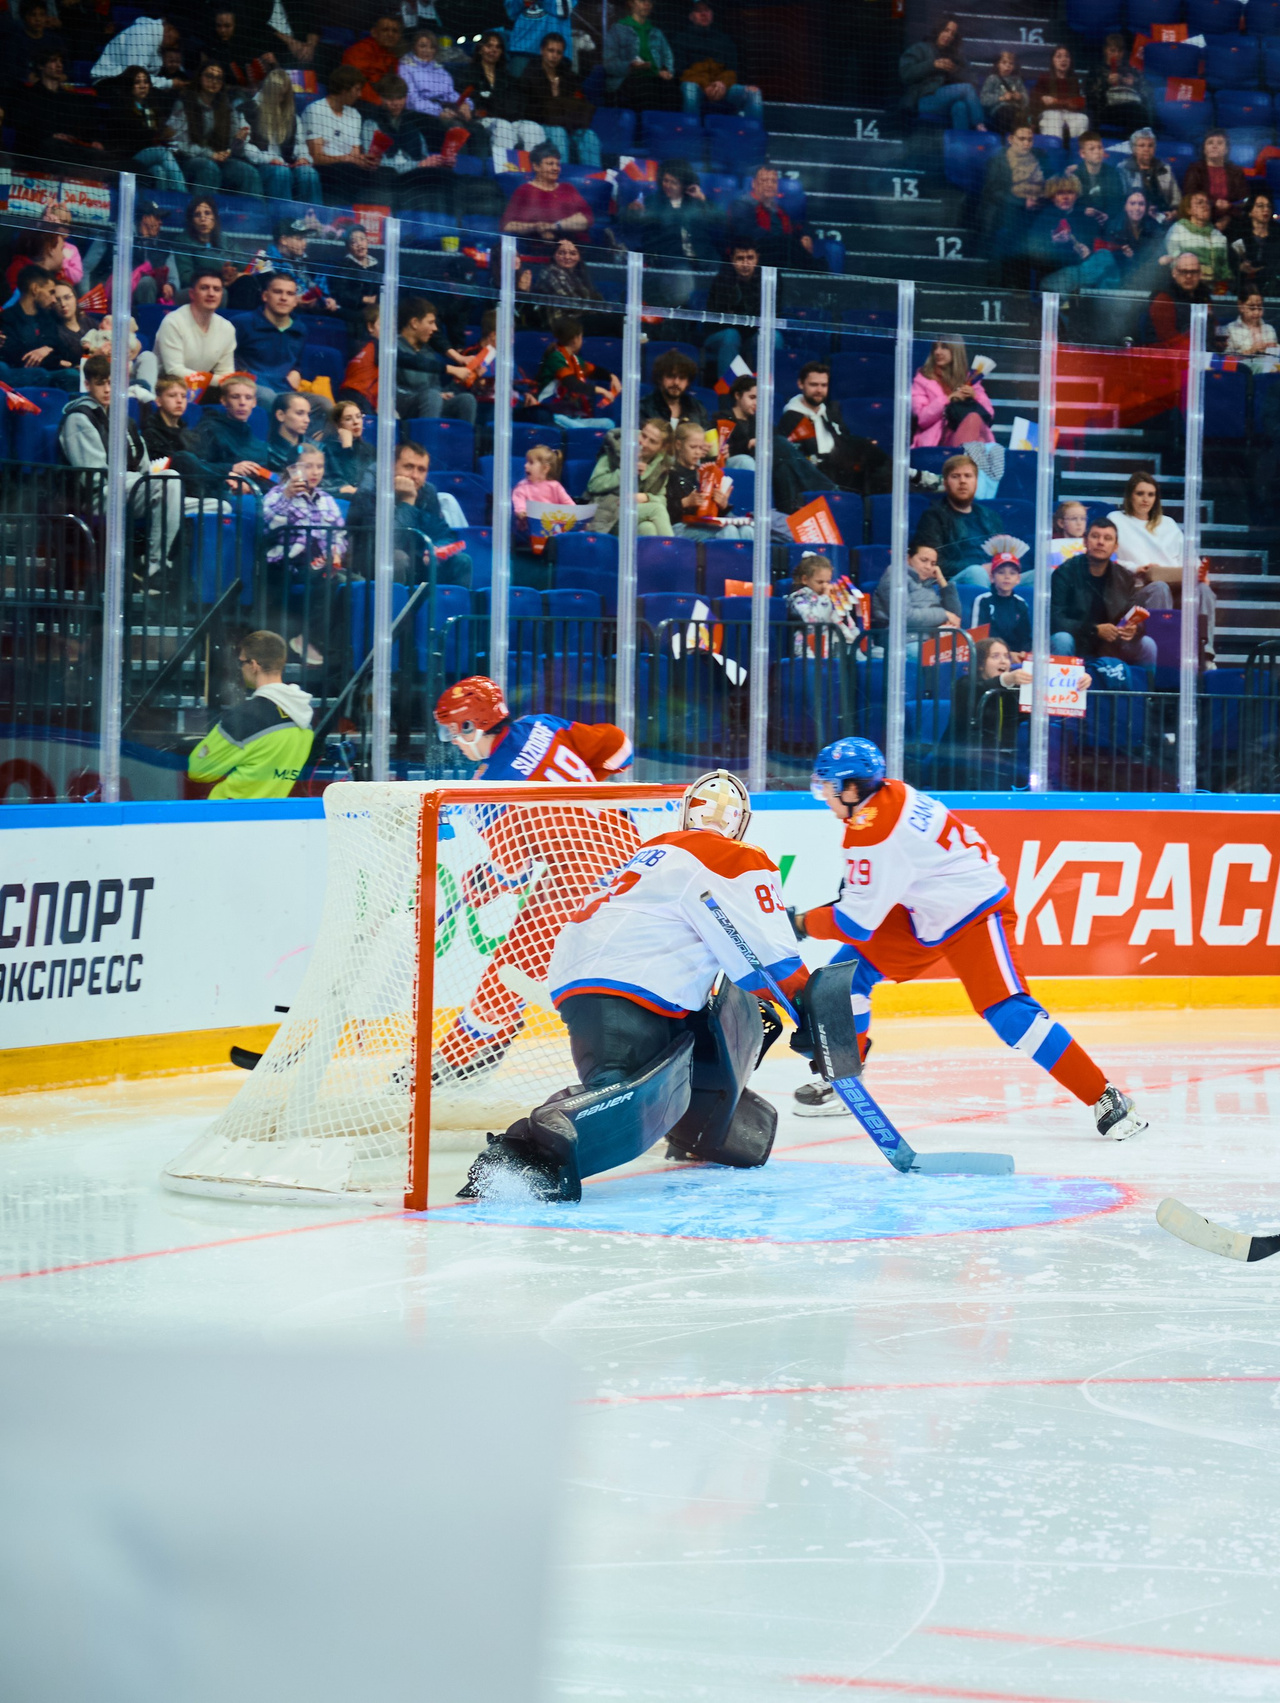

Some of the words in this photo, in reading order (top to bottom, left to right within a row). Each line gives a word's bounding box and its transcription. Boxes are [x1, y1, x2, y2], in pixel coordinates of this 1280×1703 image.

[1019, 27, 1044, 45] 16
[854, 118, 879, 141] 14
[892, 177, 919, 200] 13
[936, 236, 963, 259] 12
[981, 300, 1001, 323] 11
[846, 858, 871, 886] 79
[0, 877, 154, 949] СПОРТ
[712, 908, 760, 966] SHADOW
